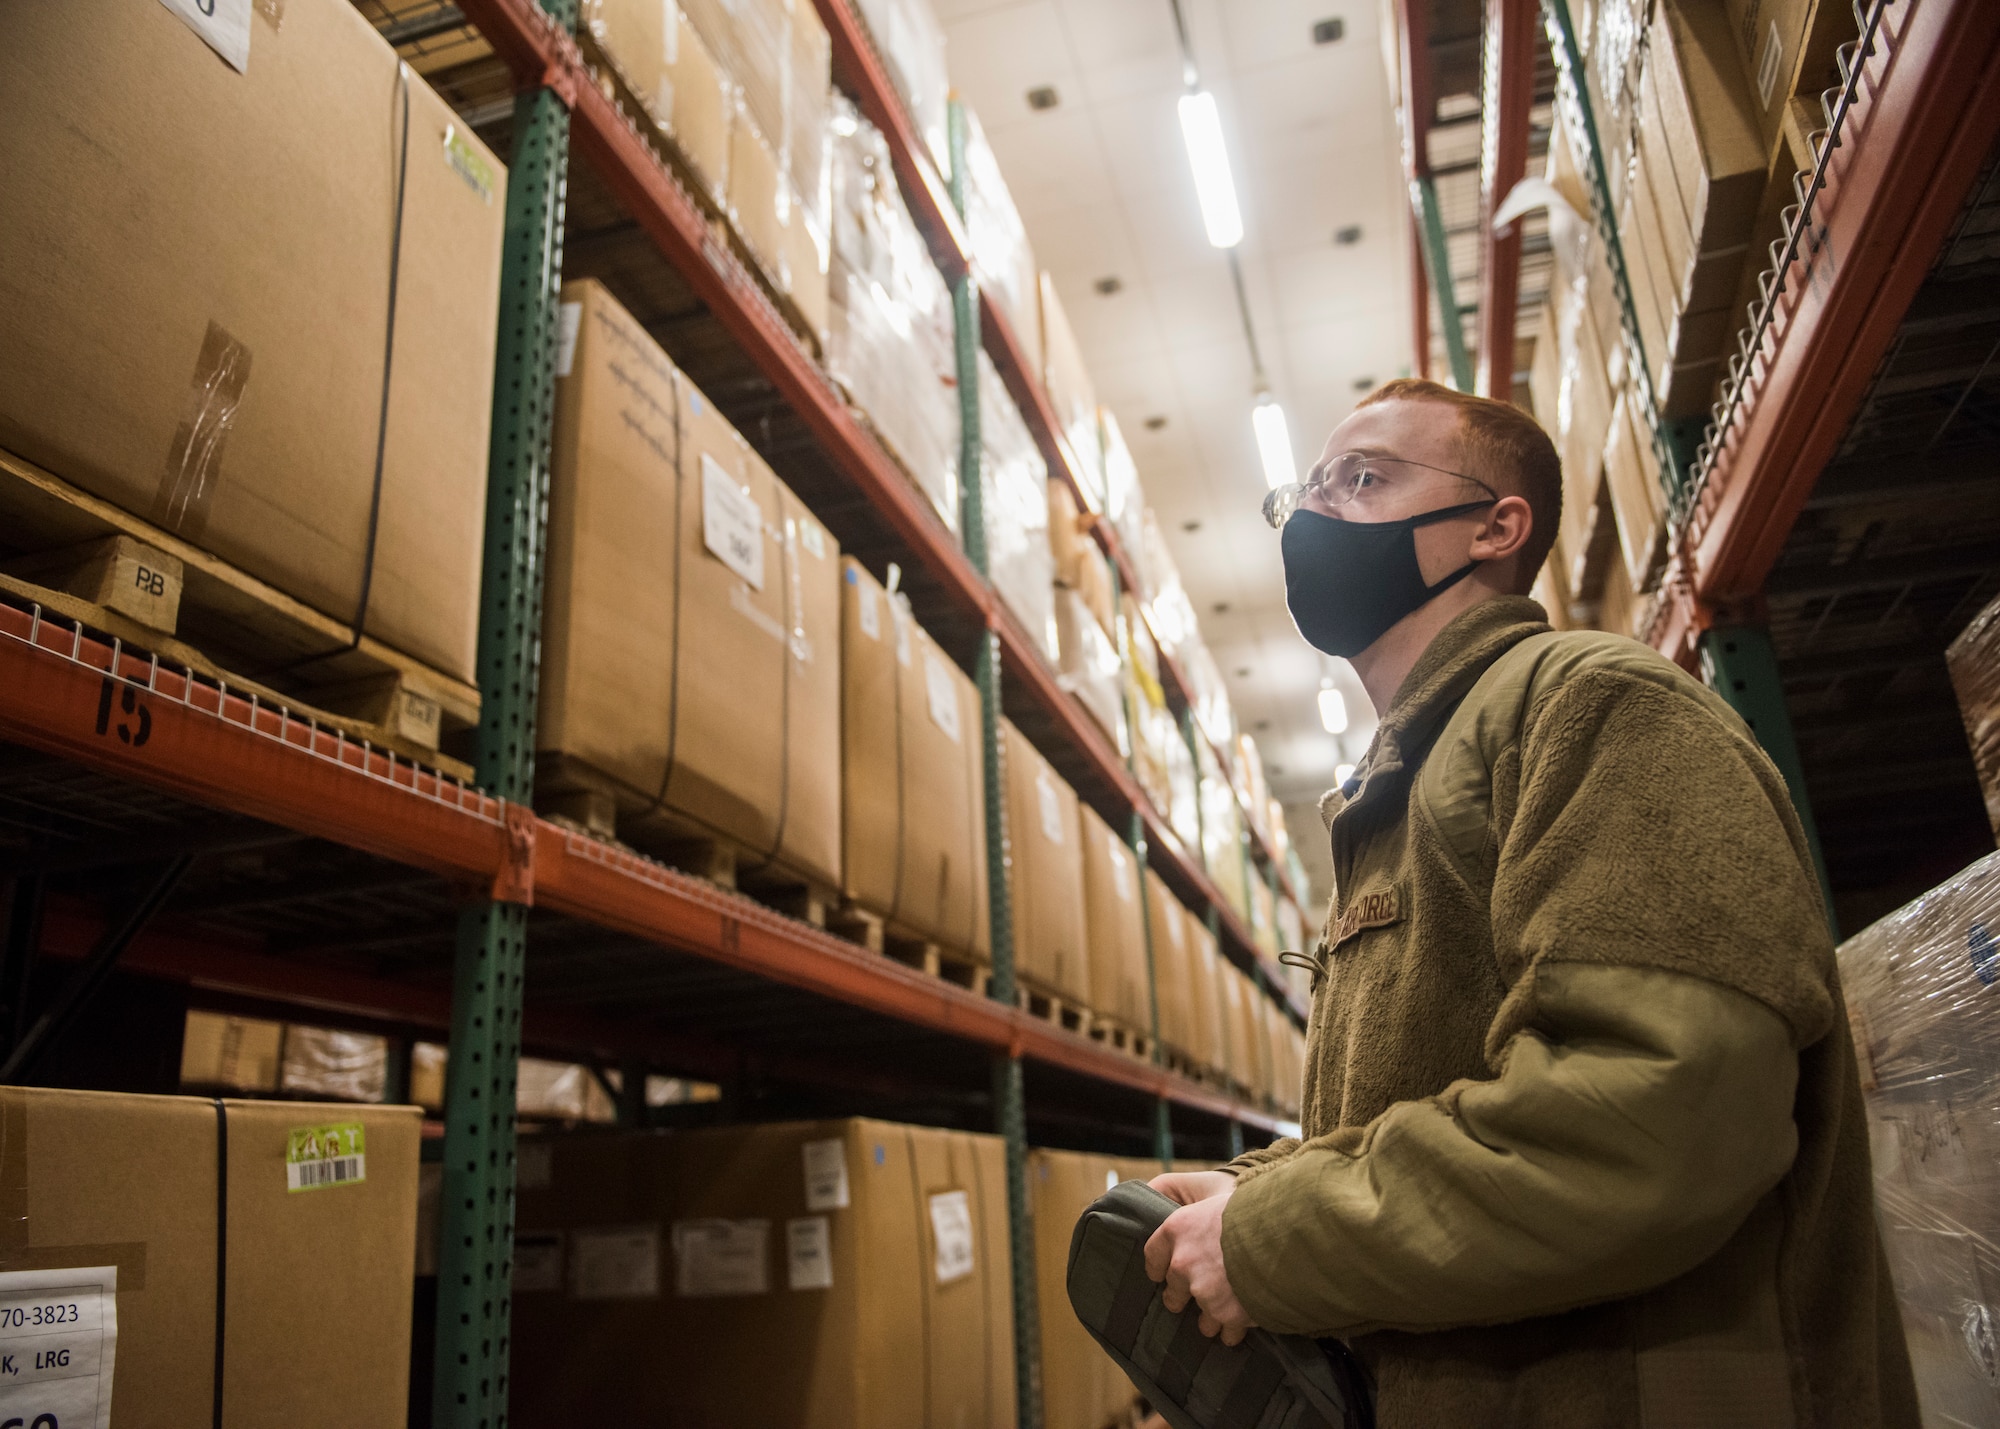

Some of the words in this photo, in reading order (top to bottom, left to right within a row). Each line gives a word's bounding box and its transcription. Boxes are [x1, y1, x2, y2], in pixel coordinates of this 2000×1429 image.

[96, 666, 152, 747] 15
[0, 1303, 79, 1328] 70-3823
[35, 1349, 71, 1370] LRG
